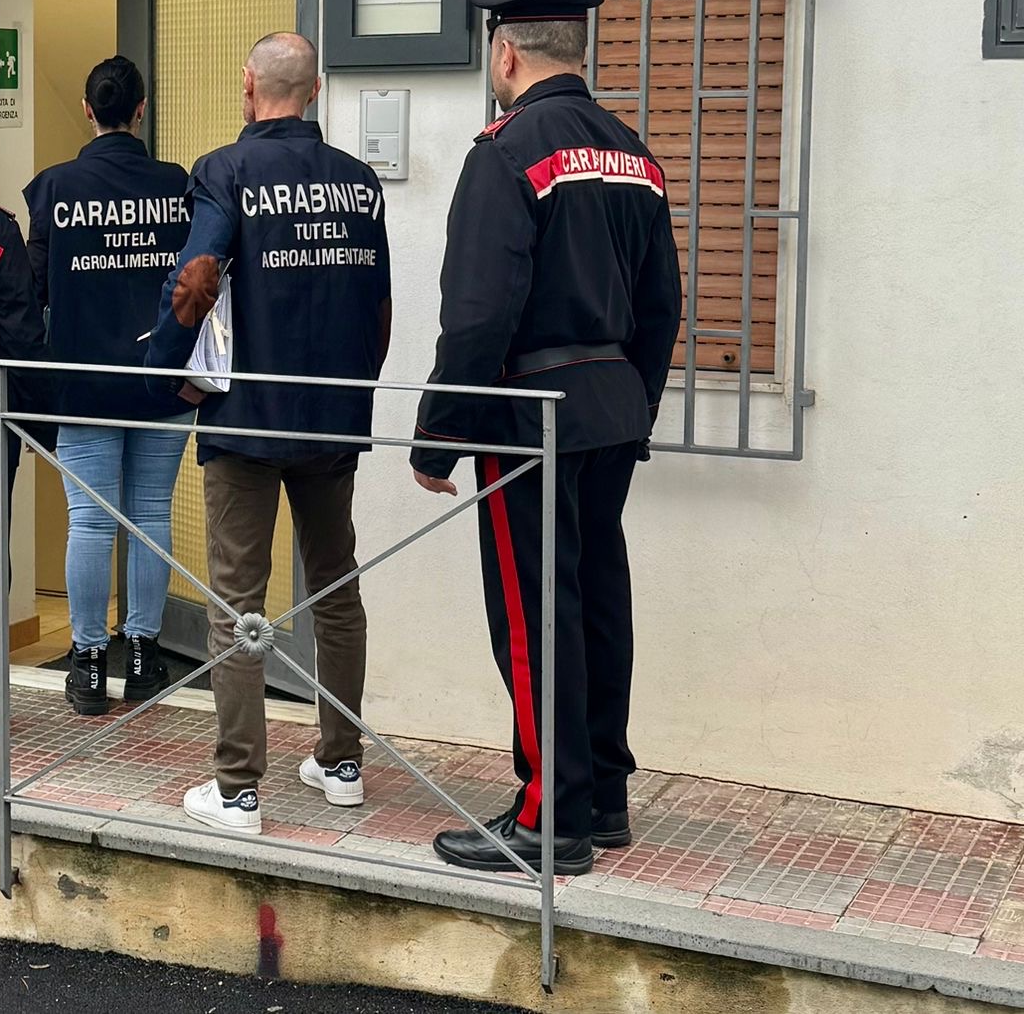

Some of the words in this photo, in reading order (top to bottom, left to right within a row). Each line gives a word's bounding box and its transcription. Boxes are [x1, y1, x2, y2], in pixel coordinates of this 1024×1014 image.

[104, 232, 156, 247] TUTELA
[294, 222, 348, 241] TUTELA
[262, 248, 376, 269] AGROALIMENTARE
